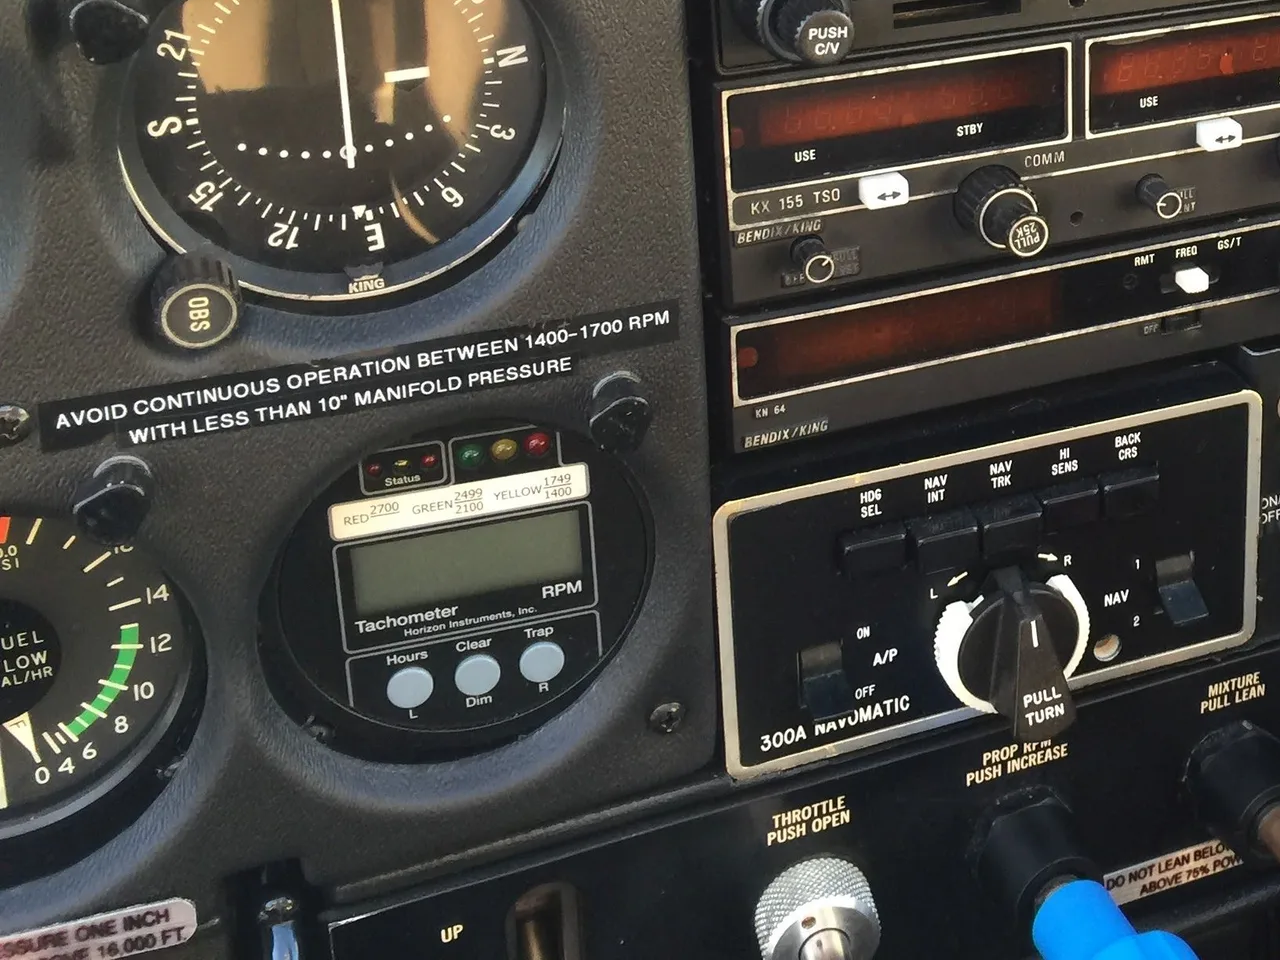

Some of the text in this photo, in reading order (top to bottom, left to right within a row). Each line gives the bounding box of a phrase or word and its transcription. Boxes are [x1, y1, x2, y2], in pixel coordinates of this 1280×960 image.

[808, 25, 848, 41] PUSH
[814, 41, 840, 56] C/V
[1139, 95, 1159, 108] USE
[956, 122, 983, 137] STBY
[794, 150, 816, 163] USE
[1024, 151, 1065, 167] COMM
[750, 188, 841, 216] KX 155 TSO
[1217, 236, 1242, 250] GS/T
[1175, 245, 1198, 258] FREQ
[1134, 253, 1155, 267] RMT
[348, 277, 385, 293] KING
[55, 309, 671, 431] AVOID CONTINUOUS OPERATION BETWEEN 1400-1700 RPM
[128, 356, 573, 445] WITH LESS THAN 10" MANIFOLD PRESSURE
[1114, 431, 1142, 448] BACK
[1118, 445, 1138, 460] CRS
[989, 460, 1013, 475] NAV
[1051, 459, 1078, 476] SENS
[384, 472, 421, 488] Status
[924, 474, 948, 489] NAV
[991, 474, 1012, 489] TRK
[860, 488, 882, 504] HDG
[927, 488, 946, 503] INT
[860, 503, 882, 518] SEL
[1104, 589, 1130, 607] NAV
[354, 580, 583, 634] Tachometer RPM
[403, 605, 537, 637] Horizon Instruments, Inc.
[524, 625, 554, 641] Trap
[455, 638, 492, 652] Clear
[386, 649, 429, 666] Hours
[872, 647, 898, 667] A/P
[855, 684, 876, 700] OFF
[1207, 671, 1261, 698] MIXTURE
[465, 693, 493, 708] Dim
[1023, 686, 1062, 708] PULL
[1200, 683, 1266, 714] PULL LEAN
[1025, 703, 1065, 727] TURN
[965, 743, 1069, 787] PUSH INCREASE
[982, 747, 1018, 767] PROP
[772, 795, 846, 829] THROTTLE
[767, 809, 850, 846] PUSH OPEN
[1128, 864, 1155, 884] NOT
[1158, 852, 1191, 874] LEAN
[1193, 842, 1229, 861] BELO
[441, 924, 464, 943] UP
